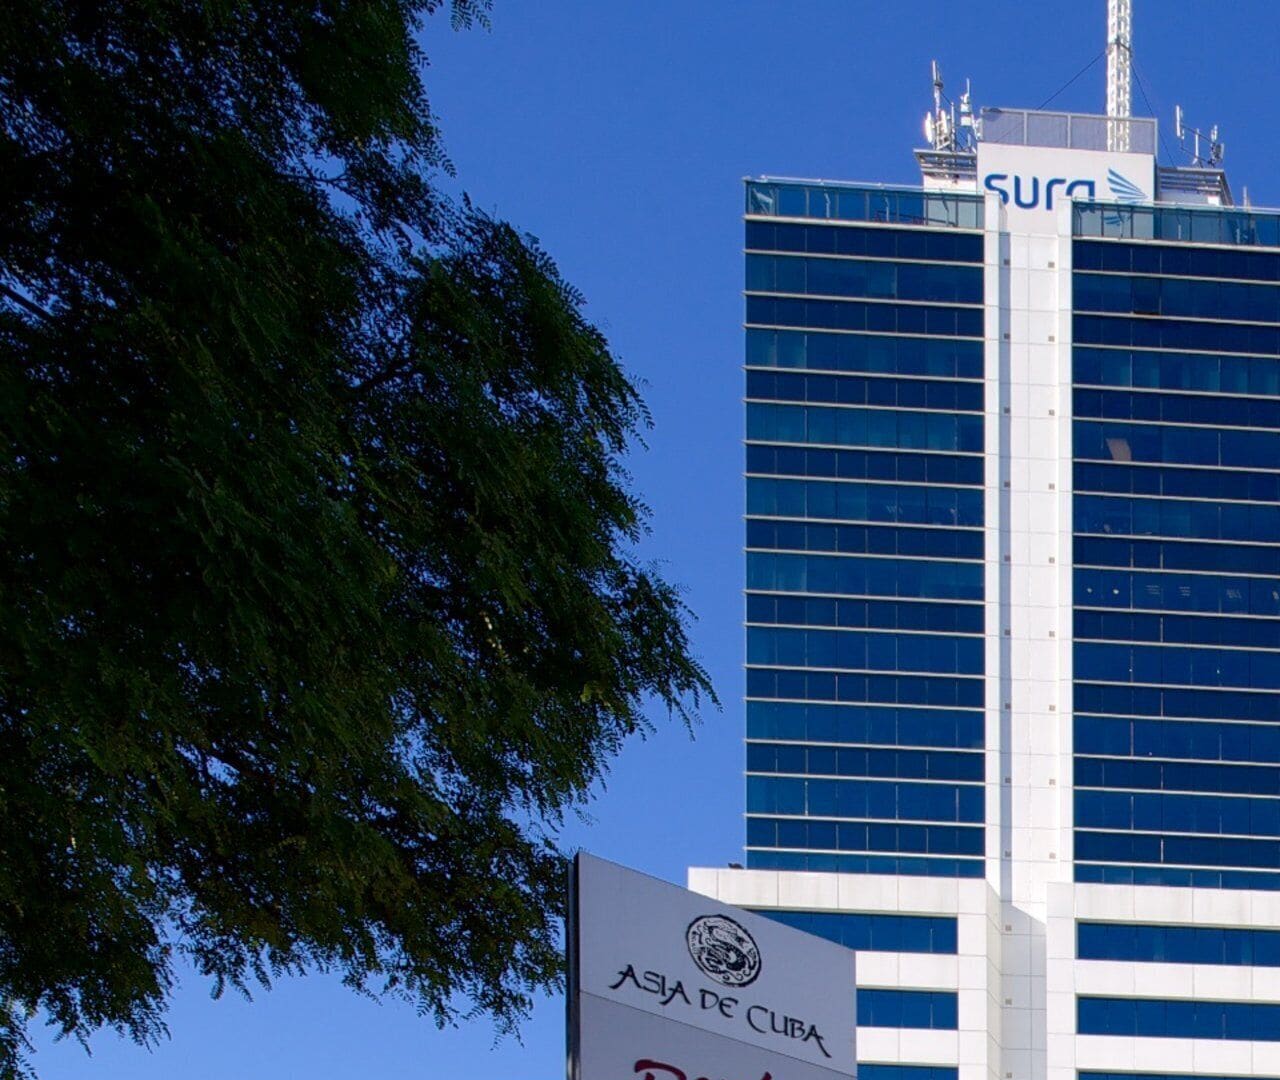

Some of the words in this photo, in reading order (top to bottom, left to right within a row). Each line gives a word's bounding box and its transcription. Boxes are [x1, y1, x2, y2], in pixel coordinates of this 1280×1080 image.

[608, 964, 690, 1006] ASIA
[698, 989, 739, 1019] DE
[746, 1005, 832, 1058] CUBA
